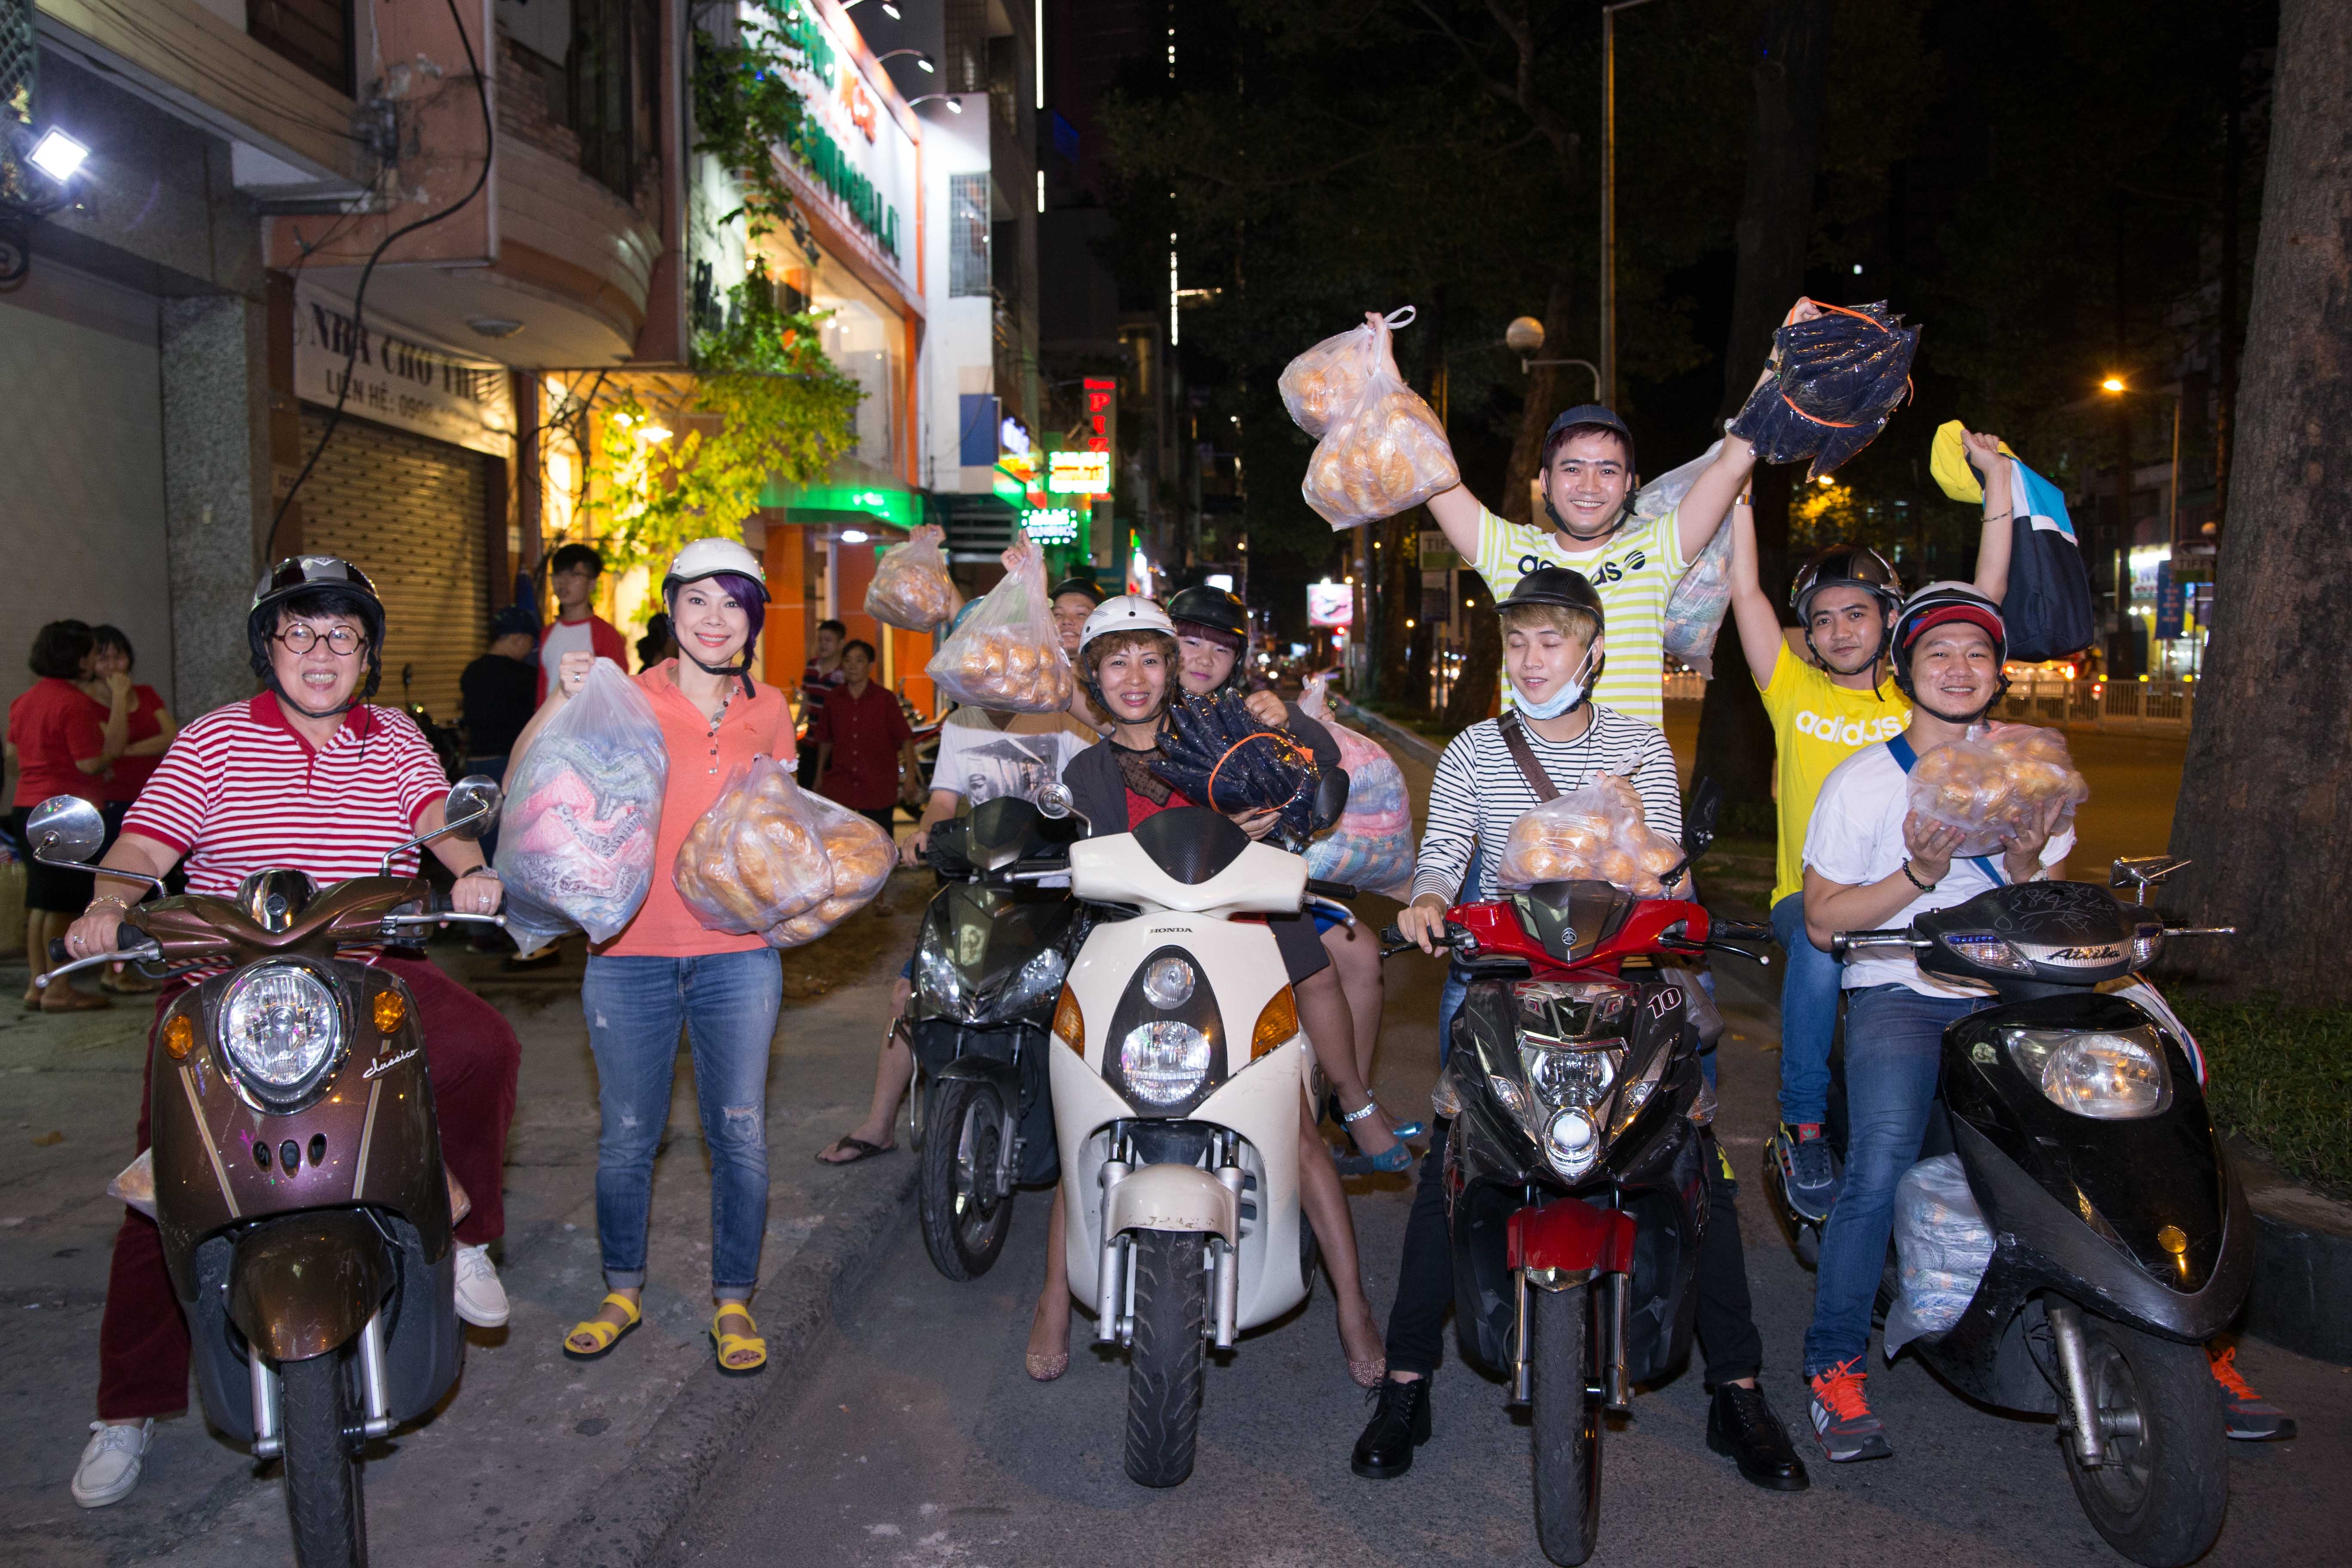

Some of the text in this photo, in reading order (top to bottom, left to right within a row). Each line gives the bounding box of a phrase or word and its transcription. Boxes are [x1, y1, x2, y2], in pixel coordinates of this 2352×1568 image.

[380, 334, 433, 386] CHO
[1795, 710, 1903, 746] adidas
[2045, 946, 2121, 961] Attila
[1647, 988, 1681, 1019] 10
